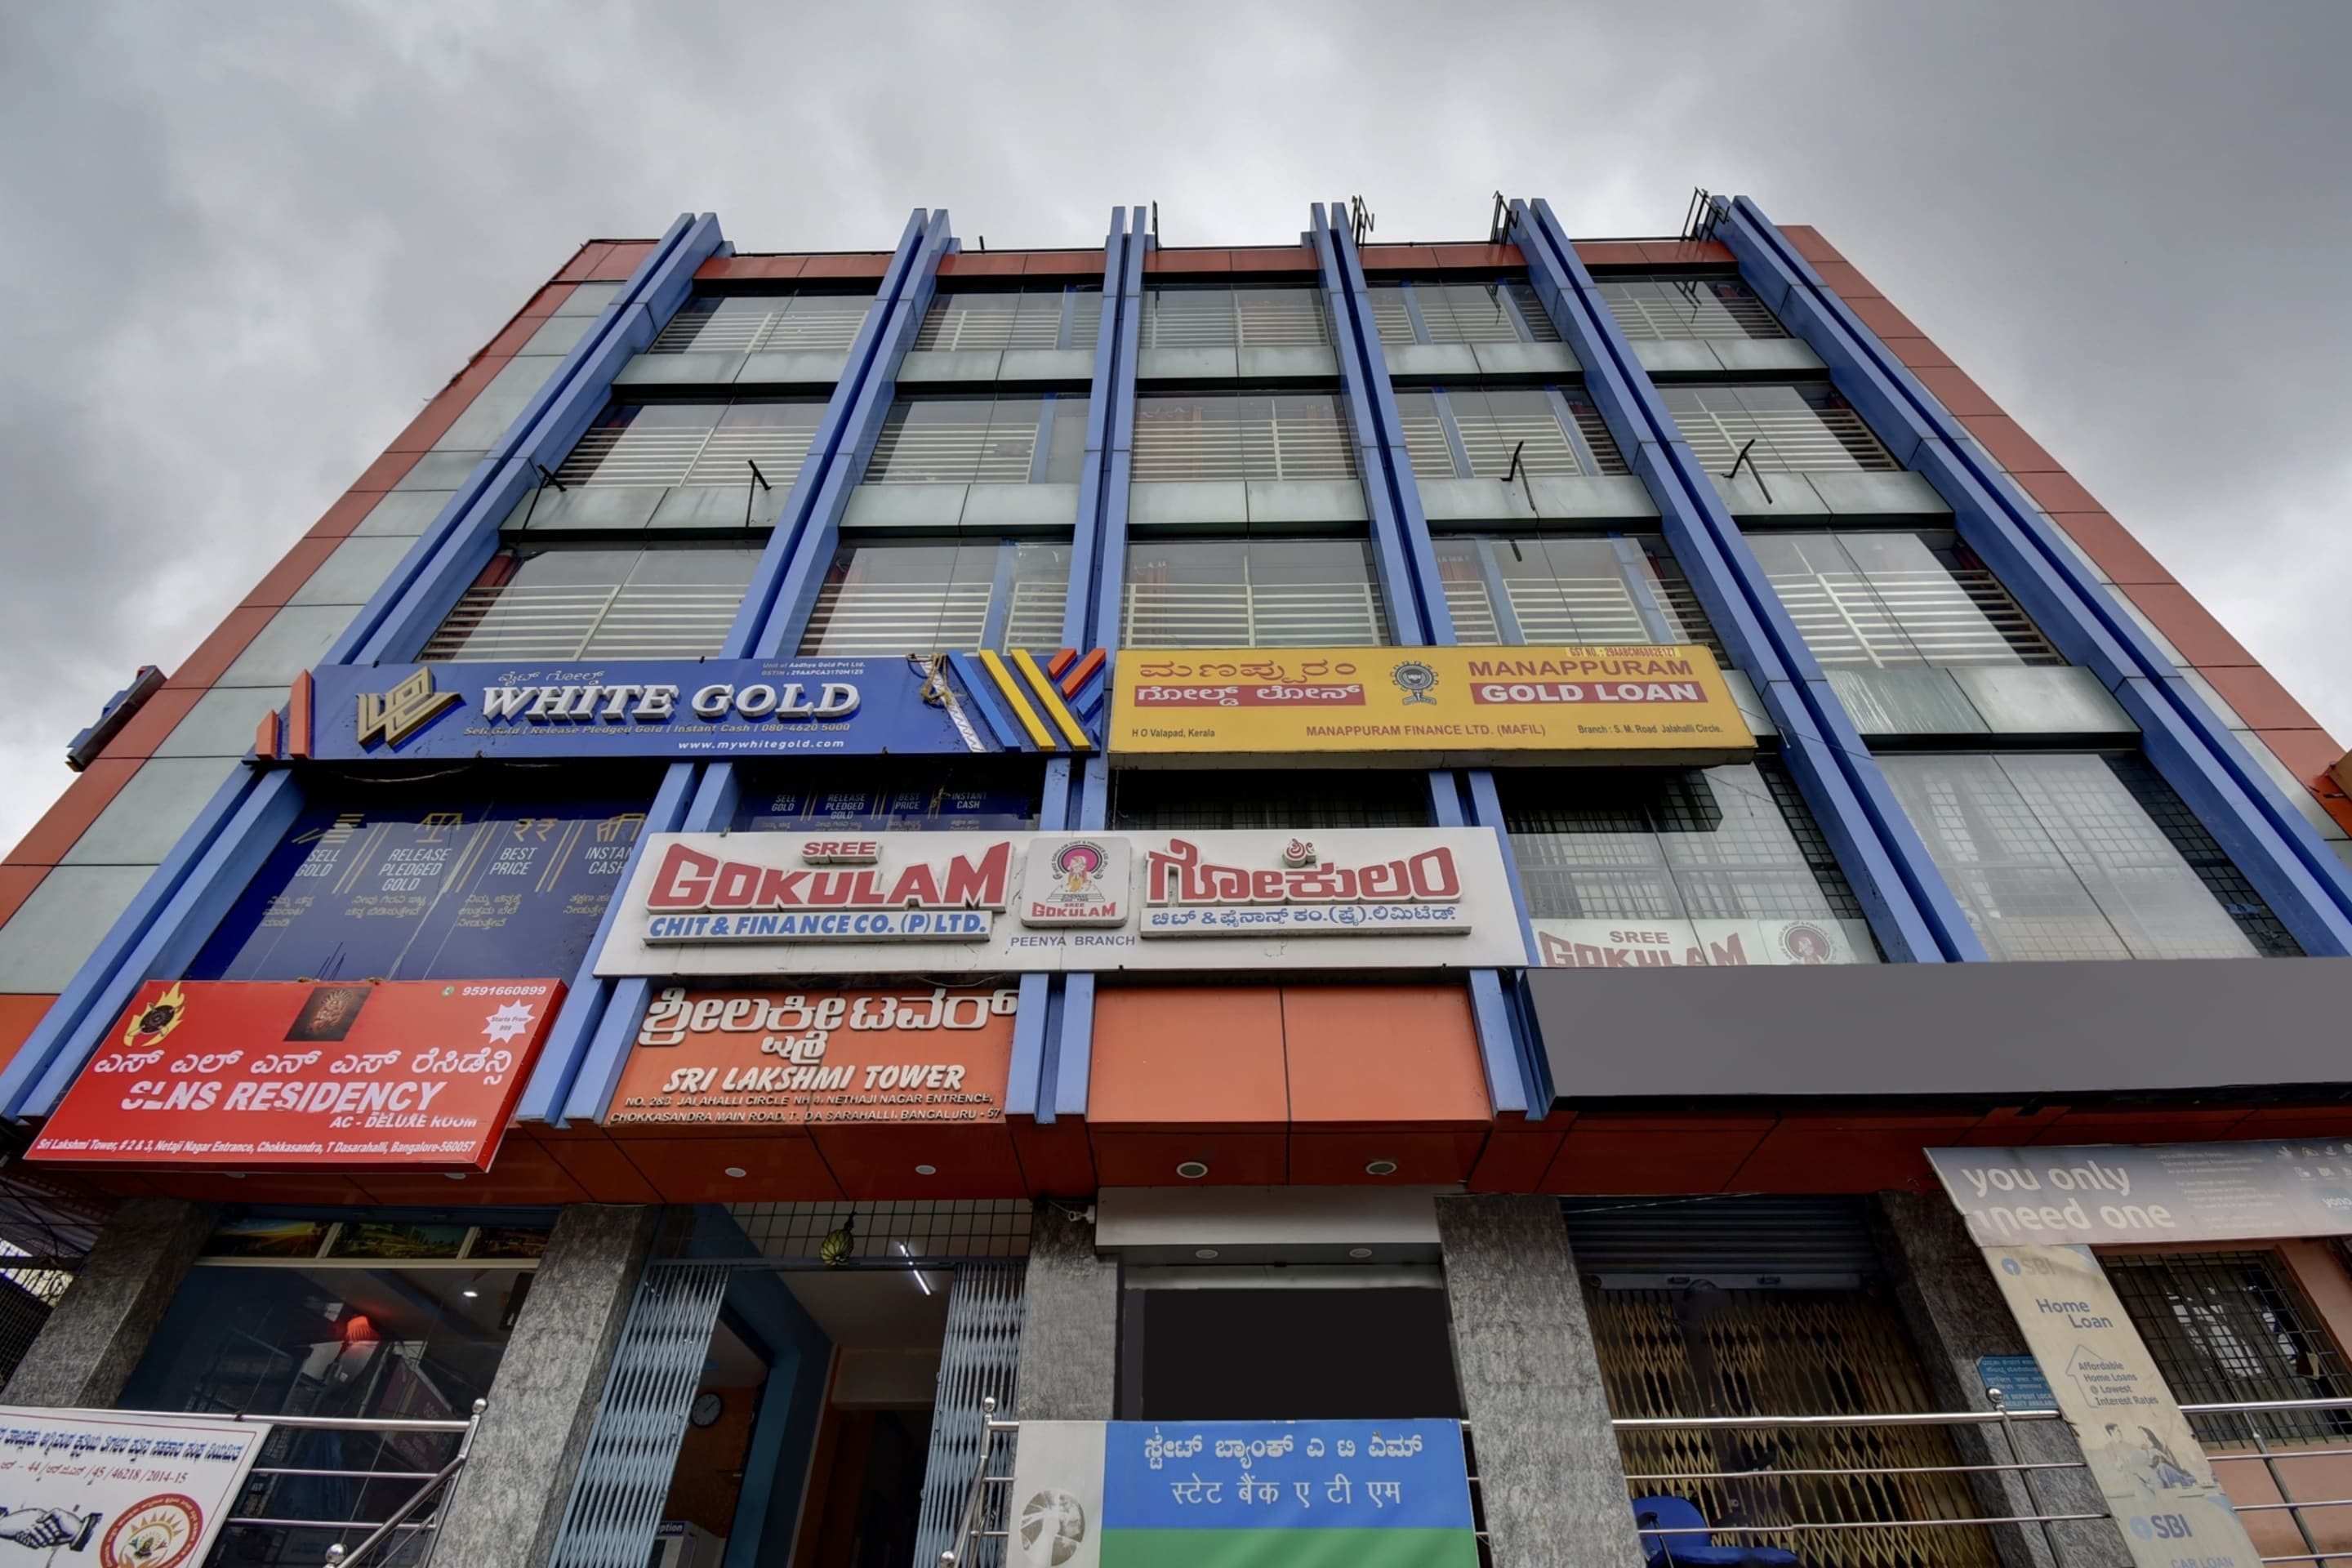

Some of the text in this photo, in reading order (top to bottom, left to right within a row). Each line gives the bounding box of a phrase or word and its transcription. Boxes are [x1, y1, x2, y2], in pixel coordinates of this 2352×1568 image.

[1468, 660, 1694, 677] MANAPPURAM
[1138, 684, 1362, 706] ಗೋಲ್ಡ್ ಲೋನ್
[1481, 684, 1699, 702] GOLD LOAN
[483, 683, 861, 720] WHITE GOLD
[492, 727, 520, 735] Gold
[531, 726, 579, 735] Release
[581, 725, 631, 736] Pledged
[635, 725, 662, 733] Gold
[674, 724, 716, 733] Instant
[720, 724, 751, 733] Cash
[762, 724, 817, 733] 080-4620
[821, 724, 851, 732] 5000
[1132, 728, 1215, 739] H O Valapad, Kerala
[1307, 724, 1546, 737] MANAPPURAM FINANCE LTD. (MAFIL)
[1577, 724, 1607, 733] Branch
[679, 739, 844, 751] www.mywhitegold.com
[776, 795, 797, 803] SELL
[827, 793, 866, 802] RELEASE
[898, 792, 920, 800] BEST
[951, 792, 987, 800] INSTANT
[771, 803, 795, 811] GOLD
[825, 802, 864, 811] PLEDGED
[895, 801, 920, 810] PRICE
[956, 800, 980, 809] CASH
[831, 811, 854, 820] GOLD
[308, 849, 341, 862] SELL
[388, 849, 452, 862] RELEASE
[500, 847, 538, 861] BEST
[585, 846, 635, 861] INSTAN
[802, 840, 878, 858] SREE
[296, 863, 332, 877] GOLD
[379, 862, 443, 876] PLEDGED
[490, 862, 533, 875] PRICE
[648, 840, 1012, 908] GOKULAM
[1147, 837, 1461, 902] ಗೋಕುಲಂ
[381, 877, 421, 892] GOLD
[1032, 902, 1116, 917] GOKULAM
[650, 913, 987, 937] CHIT & FINANCE CO. (P) LTD.
[1200, 915, 1217, 924] &
[1010, 936, 1135, 947] PEENYA BRANCH
[1609, 930, 1670, 944] SREE
[461, 986, 547, 996] 9591660899
[849, 988, 1019, 1031] ಟವರ್
[94, 1049, 165, 1073] ಎಸ್
[170, 1049, 244, 1074] ಎಲ್
[251, 1050, 323, 1074] ಎನ್
[330, 1049, 402, 1074] ಎಸ್
[662, 1064, 967, 1093] SRI LAKSHMI TOWER
[223, 1080, 448, 1115] RESIDENCY
[625, 1097, 646, 1106] NO.
[650, 1097, 672, 1106] 2&3
[677, 1096, 742, 1106] JALAHALLI
[746, 1096, 790, 1105] CIRCLE
[793, 1095, 811, 1104] NH
[826, 1094, 877, 1104] NETHAJI
[880, 1094, 923, 1103] NAGAR
[329, 1116, 354, 1129] AC
[365, 1113, 427, 1129] DELUXE
[610, 1112, 713, 1122] CHOKKASANDRA
[715, 1112, 745, 1121] MAIN
[987, 1108, 1001, 1118] 57
[37, 1138, 52, 1150] Sri
[52, 1138, 91, 1150] Lakshmi
[91, 1139, 118, 1152] Tower,
[154, 1140, 184, 1152] Netaji
[184, 1141, 211, 1154] Nagar
[211, 1141, 255, 1153] Entrance,
[257, 1141, 323, 1154] Chokkasandra,
[390, 1141, 475, 1155] Bangalore-560057
[1962, 1160, 2131, 1198] you only
[2100, 1205, 2176, 1228] one
[2020, 1258, 2056, 1276] SBI
[2035, 1298, 2091, 1313] Home
[2068, 1314, 2114, 1329] Loan
[2078, 1361, 2124, 1371] Affordable
[2083, 1373, 2138, 1382] Home Loans
[2100, 1385, 2132, 1393] Lowest
[2095, 1396, 2159, 1405] Interest Rates
[1214, 1434, 1294, 1469] ಬ್ಯಾಂಕ್
[1169, 1472, 1401, 1508] स्टेट बैंक ए टी एम
[660, 1522, 684, 1533] ption
[2151, 1513, 2194, 1539] SBI
